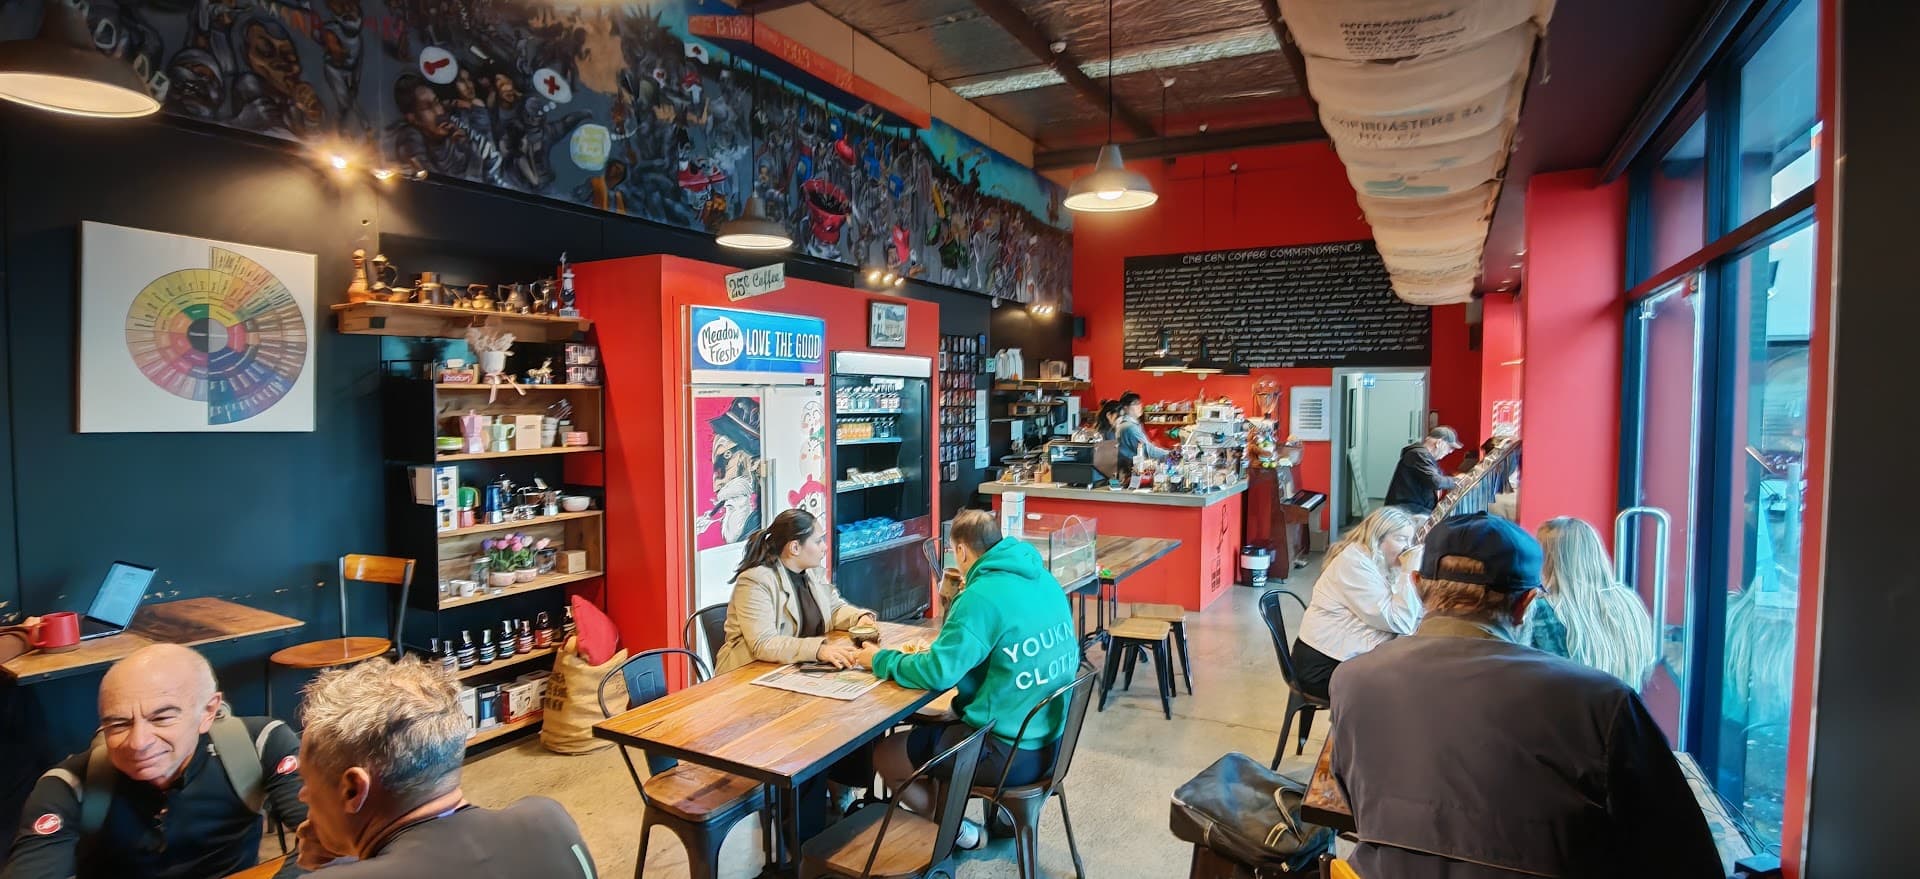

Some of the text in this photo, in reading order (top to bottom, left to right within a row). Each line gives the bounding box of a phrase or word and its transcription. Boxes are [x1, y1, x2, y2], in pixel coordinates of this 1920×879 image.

[752, 269, 780, 291] Coffee
[702, 320, 740, 349] Meadow
[746, 328, 820, 359] LOVE THE GOOD
[708, 341, 737, 362] Fresh
